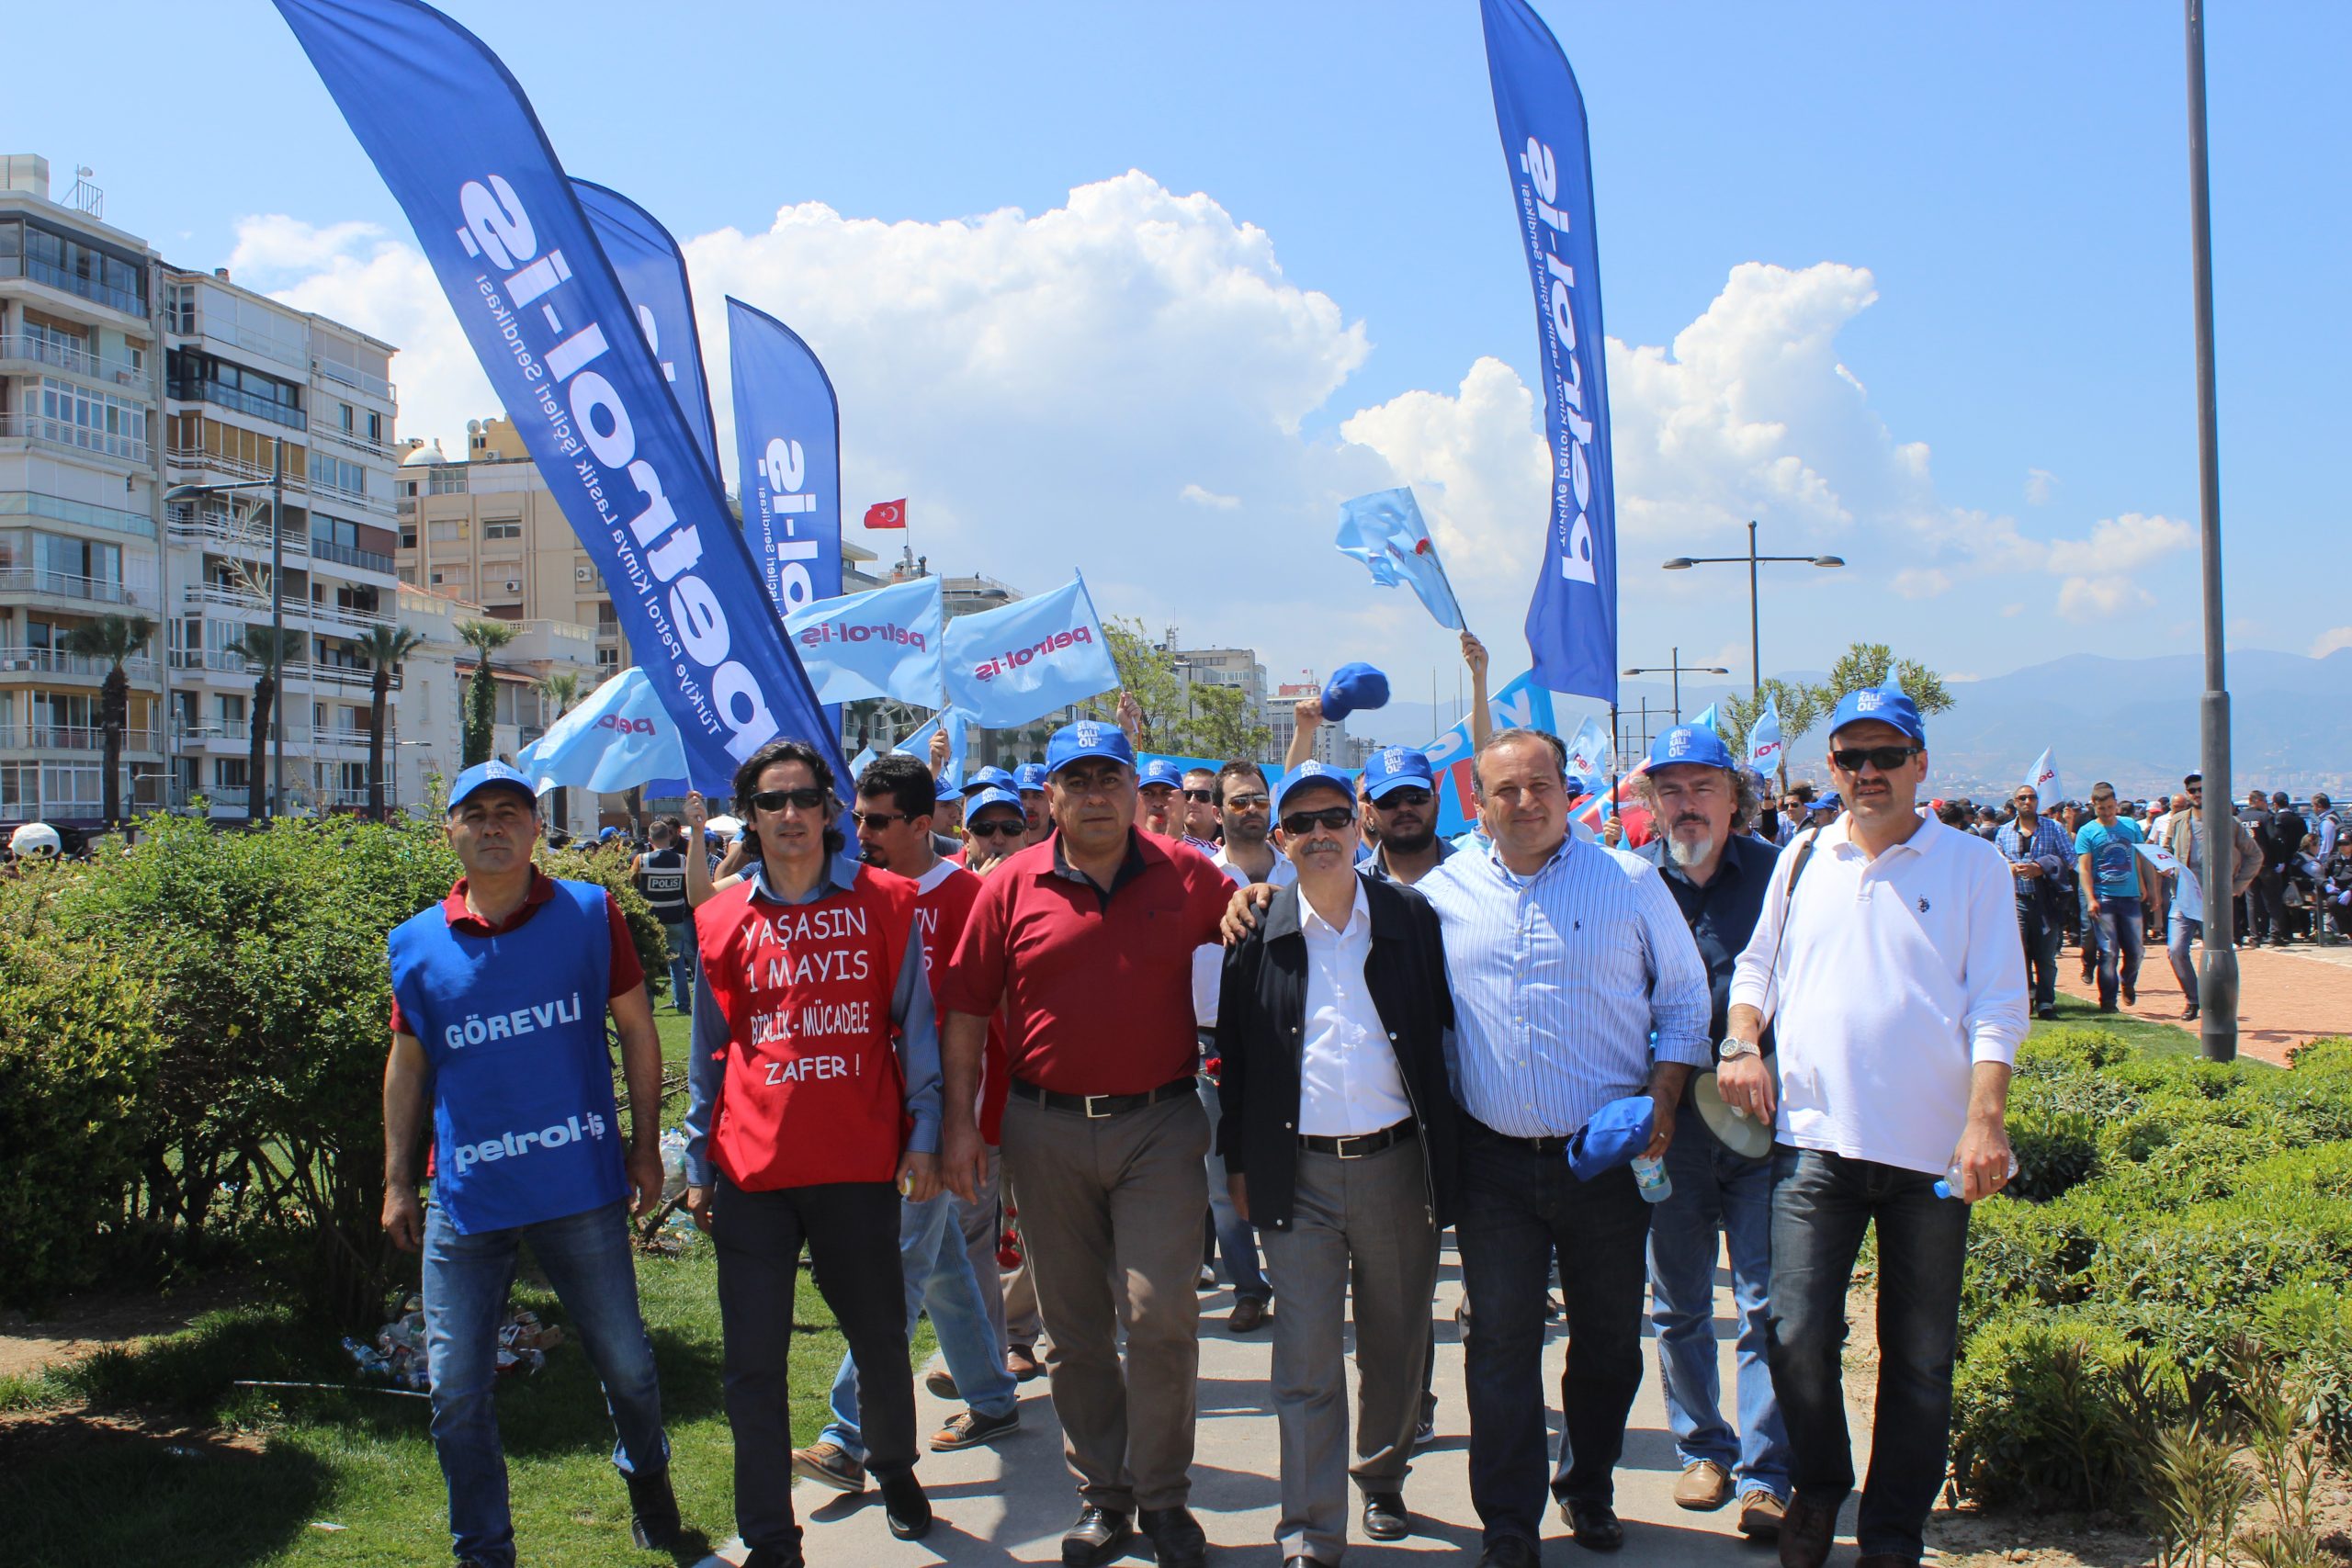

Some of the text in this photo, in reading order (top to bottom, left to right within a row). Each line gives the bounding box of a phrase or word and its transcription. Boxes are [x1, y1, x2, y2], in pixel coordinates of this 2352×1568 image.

[1858, 694, 1881, 705] KALI
[1857, 702, 1875, 712] OL
[1077, 728, 1098, 739] KALI
[1079, 738, 1096, 748] OL
[1669, 738, 1687, 748] KALI
[1668, 745, 1683, 758] OL
[1385, 756, 1401, 767] KALI
[1386, 764, 1399, 774] OL
[651, 878, 678, 888] POLİS
[741, 907, 867, 951] YAŞASIN
[747, 949, 869, 993] 1 MAYIS
[445, 992, 582, 1049] GÖREVLİ
[751, 1003, 792, 1046] BİRLİK
[803, 998, 869, 1038] MÜCADELE
[764, 1055, 848, 1086] ZAFER
[456, 1111, 605, 1173] petrol-iş
